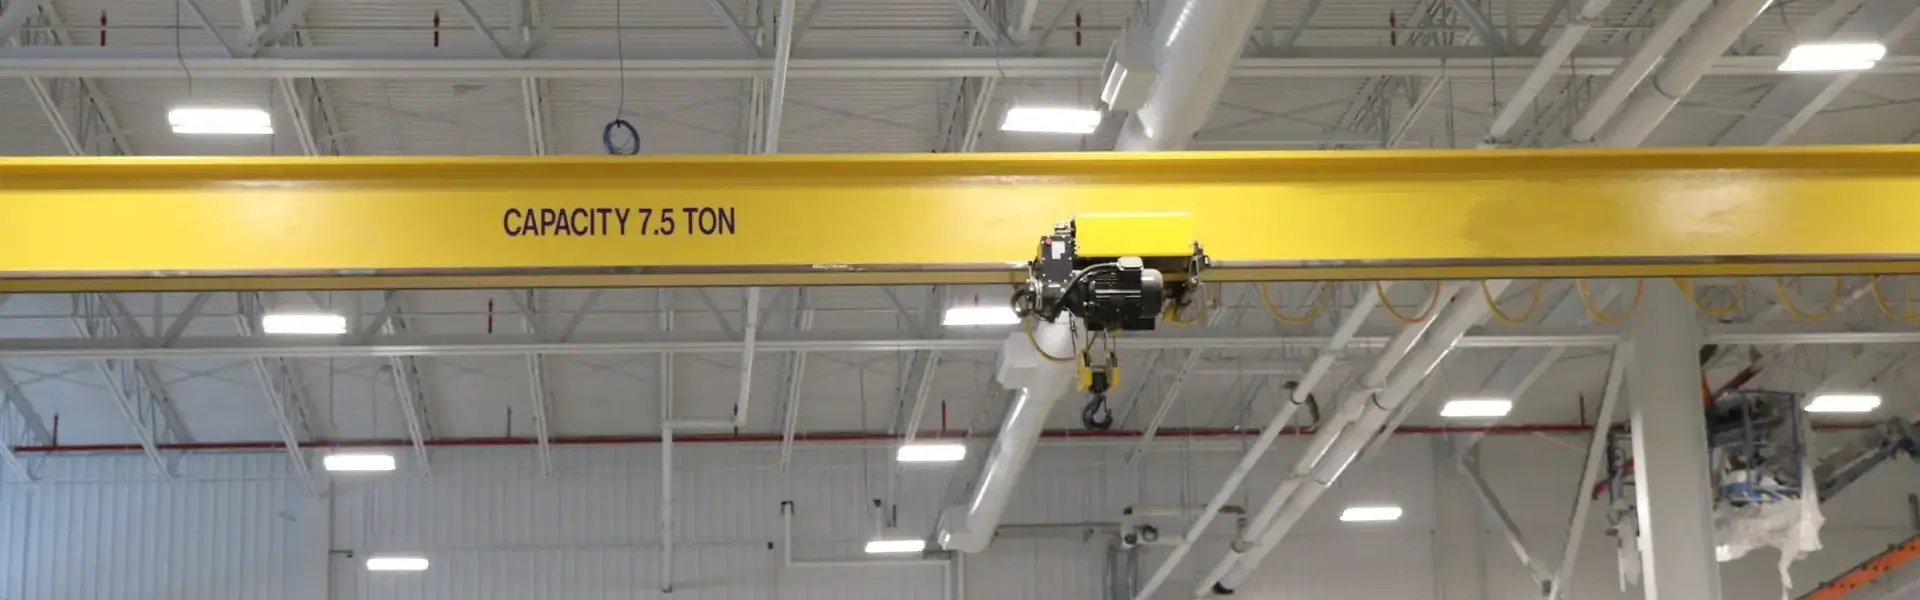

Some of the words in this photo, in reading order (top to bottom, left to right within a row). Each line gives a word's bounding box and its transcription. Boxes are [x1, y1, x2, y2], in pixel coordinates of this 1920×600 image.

[503, 207, 631, 237] CAPACITY
[638, 207, 676, 236] 7.5
[682, 206, 736, 236] TON
